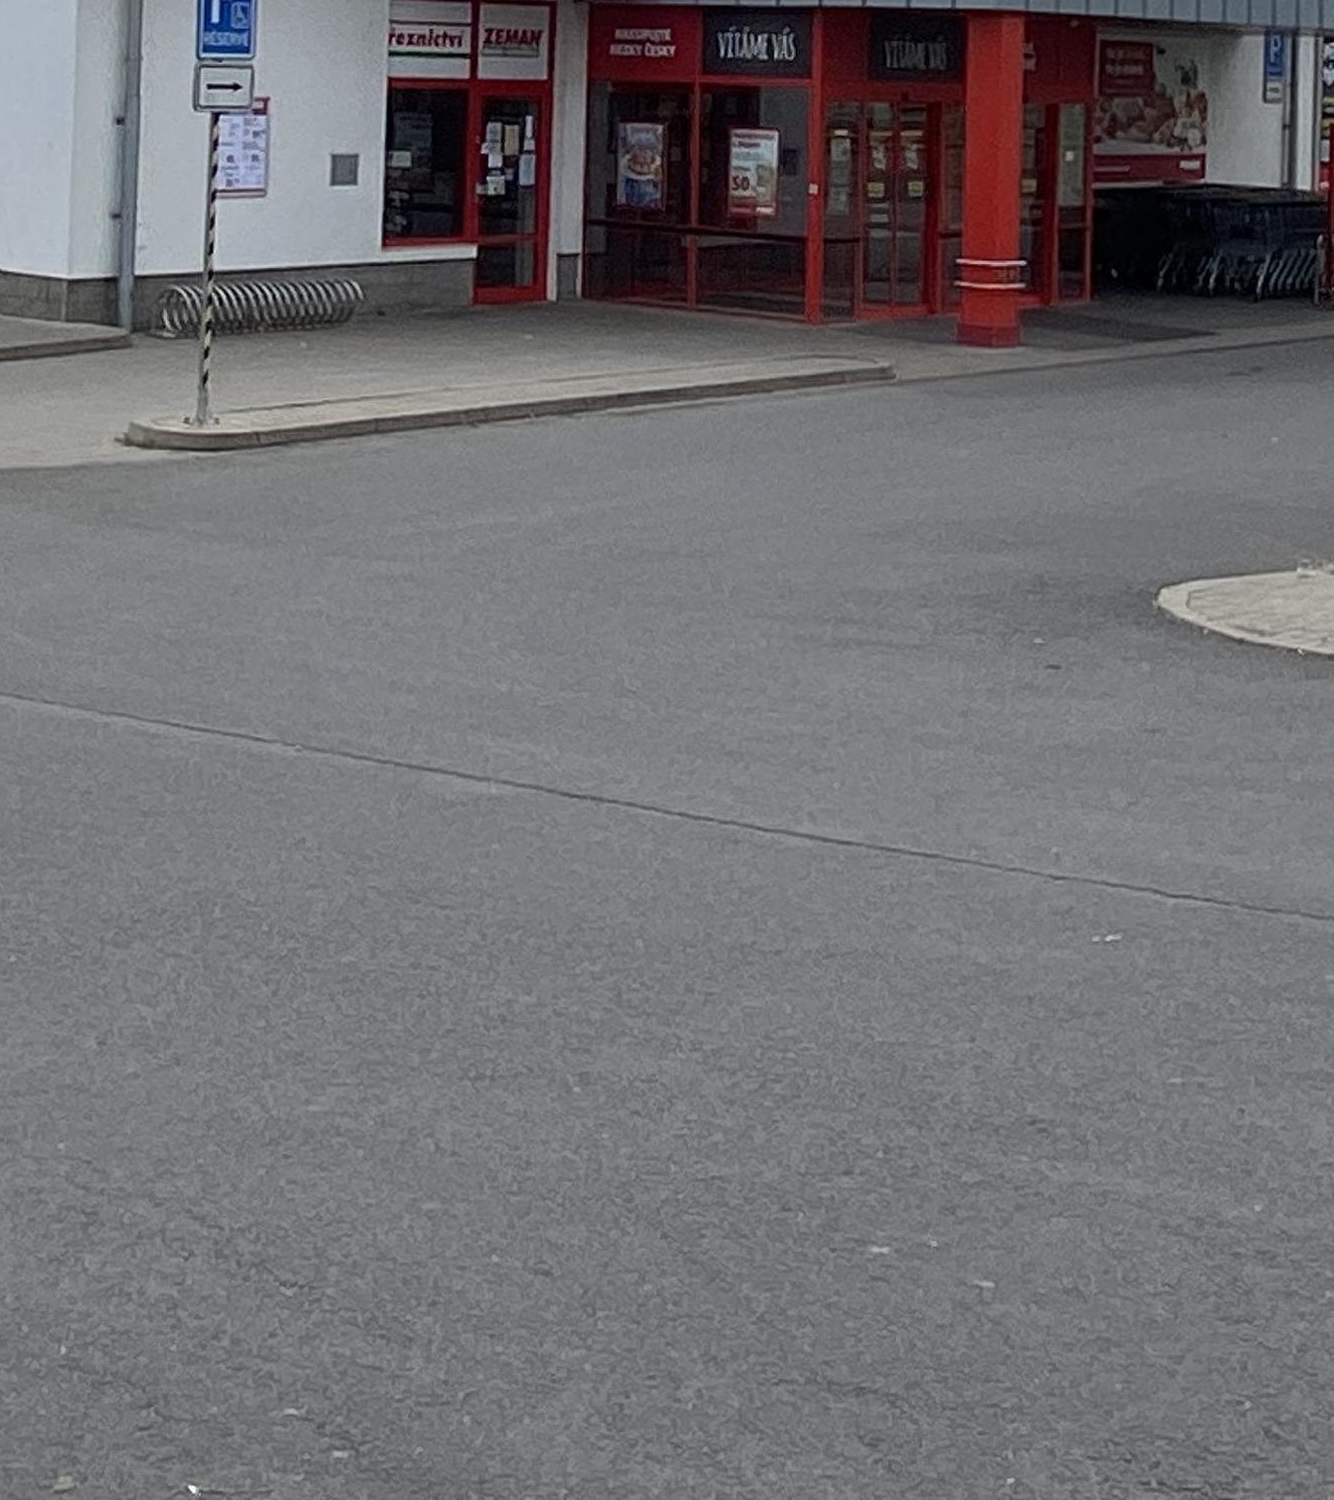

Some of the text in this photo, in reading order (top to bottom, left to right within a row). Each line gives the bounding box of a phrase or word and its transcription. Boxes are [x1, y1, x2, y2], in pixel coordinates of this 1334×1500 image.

[482, 28, 544, 47] ZEMAN
[716, 25, 797, 61] VÍTÁME VÁS
